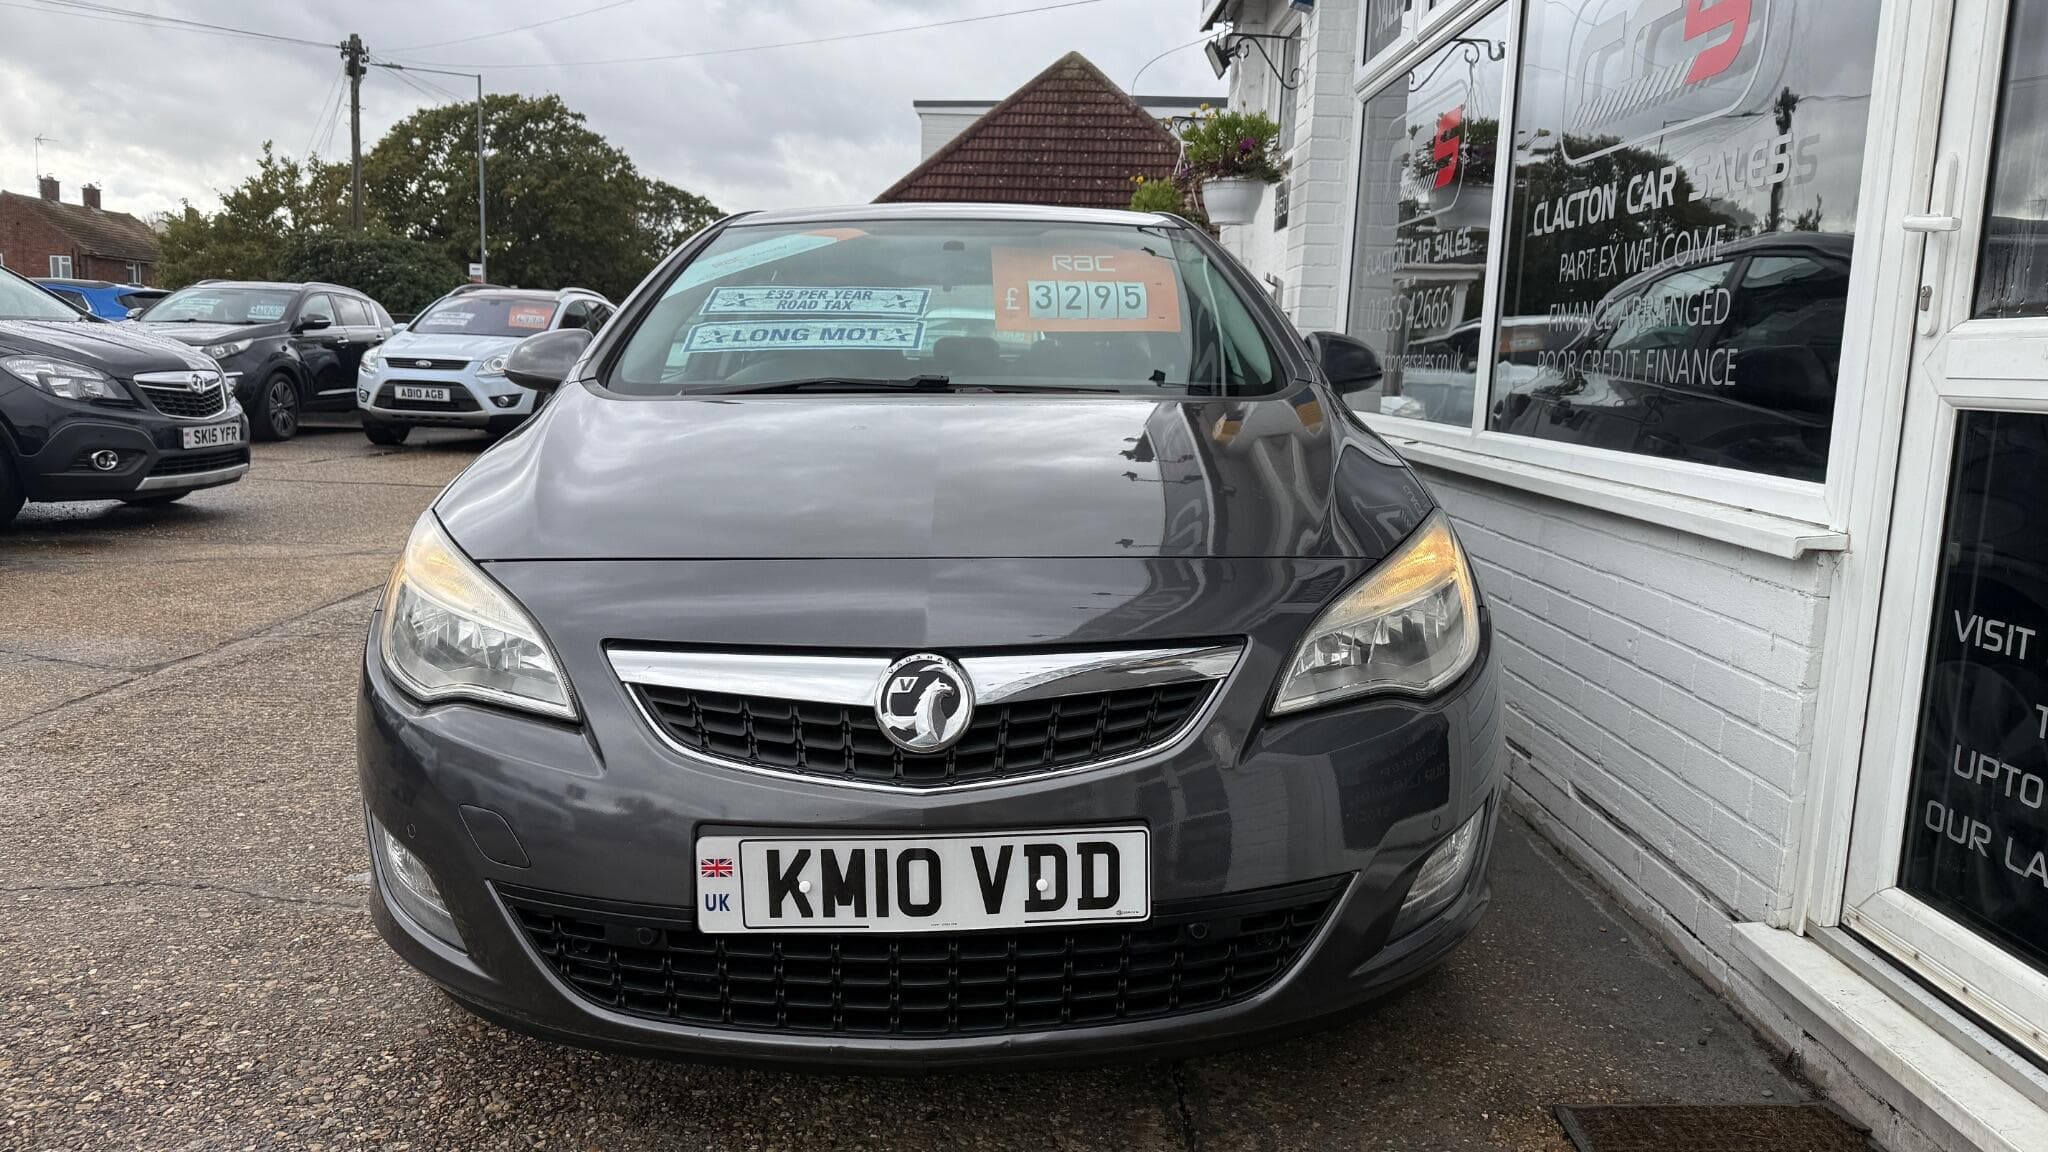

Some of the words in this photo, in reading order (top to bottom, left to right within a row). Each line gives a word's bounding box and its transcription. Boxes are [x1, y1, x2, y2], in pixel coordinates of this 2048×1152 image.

[1533, 181, 1617, 236] CLACTON
[1626, 166, 1677, 215] CAR
[1689, 132, 1792, 201] SALES
[1409, 237, 1431, 265] CAR
[1434, 226, 1471, 262] SALES
[1559, 248, 1595, 283] PART
[1600, 242, 1618, 278] EX
[1624, 224, 1726, 273] WELCOME
[765, 290, 793, 300] £35
[801, 290, 828, 300] PER
[835, 290, 873, 301] YEAR
[776, 300, 817, 310] ROAD
[823, 300, 854, 311] TAX
[1406, 285, 1457, 329] 426661
[1548, 298, 1614, 333] FINANCE
[1618, 287, 1731, 329] ARRANGED
[732, 329, 810, 343] LONG
[819, 327, 882, 342] MOT
[1537, 350, 1576, 380] POOR
[1581, 349, 1640, 381] CREDIT
[1645, 348, 1739, 386] FINANCE
[194, 428, 217, 444] SK15
[220, 426, 237, 441] YFR
[1955, 609, 2036, 660] VISIT
[1954, 744, 2043, 809] UPTO
[1926, 800, 1992, 857] OUR
[767, 848, 942, 918] KM10
[970, 842, 1120, 914] VDD
[705, 894, 730, 911] UK
